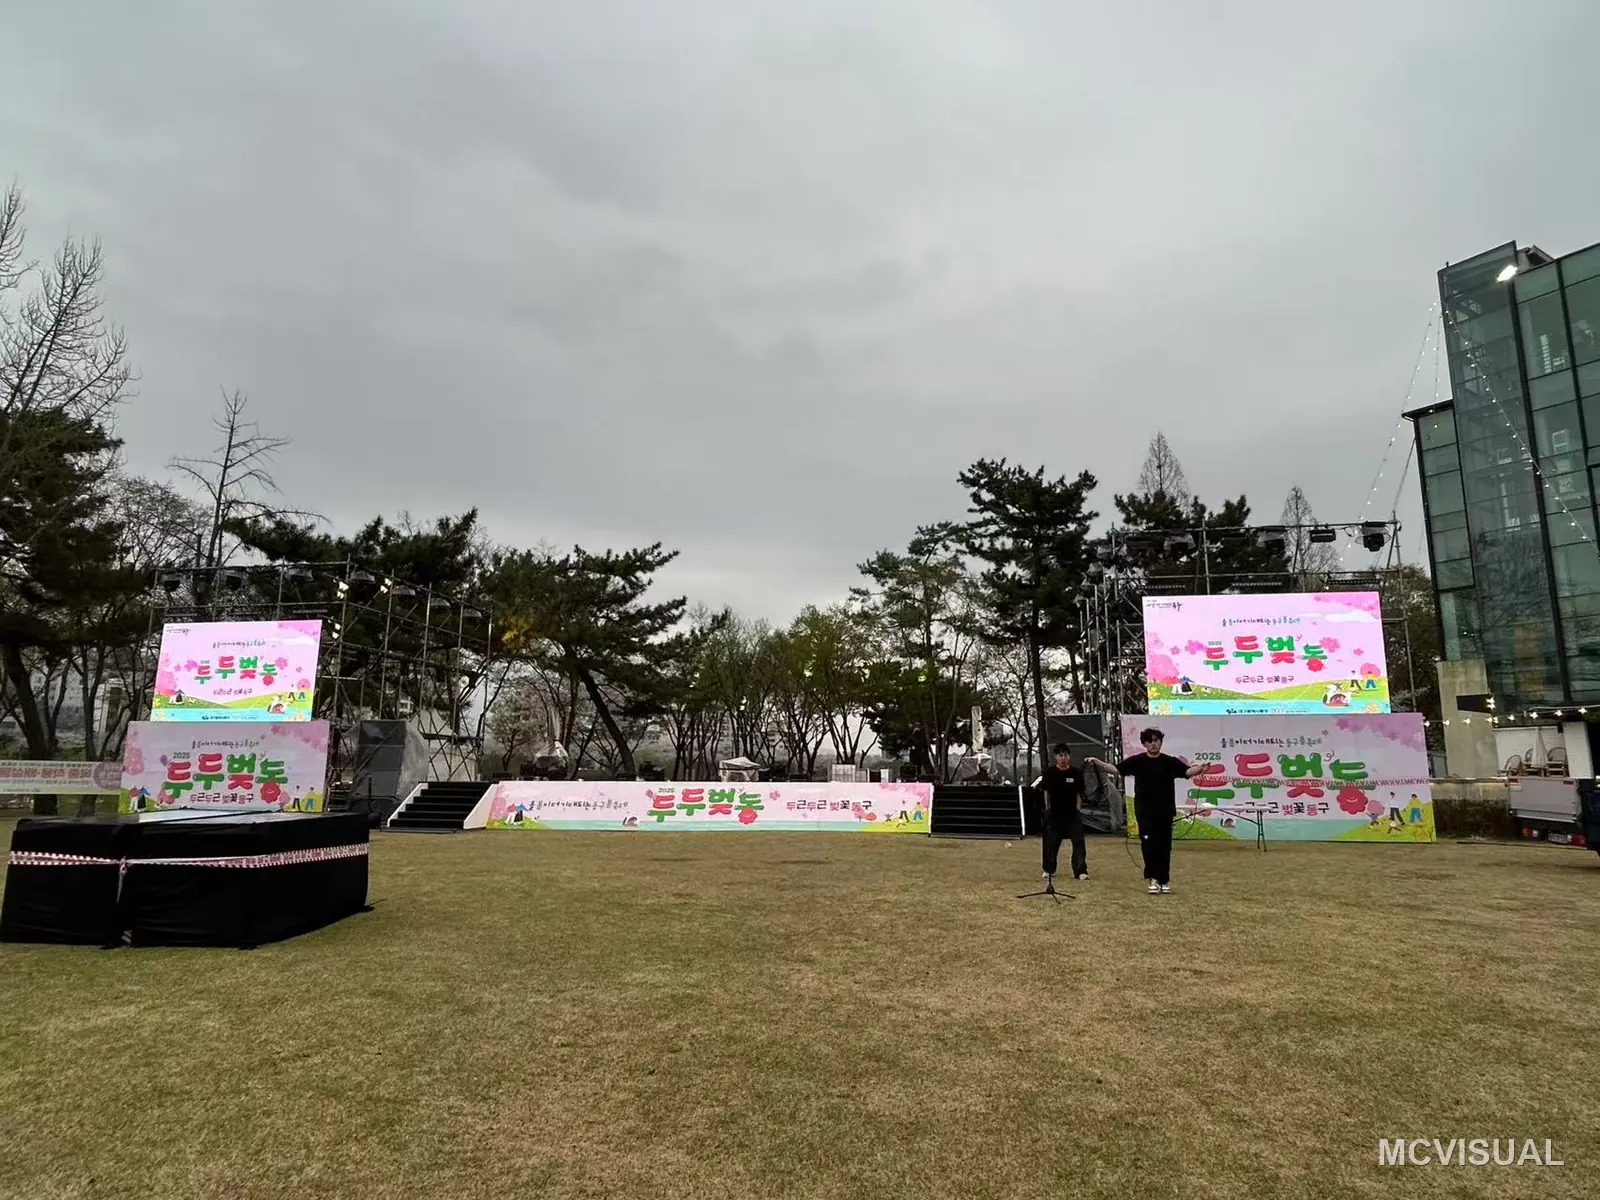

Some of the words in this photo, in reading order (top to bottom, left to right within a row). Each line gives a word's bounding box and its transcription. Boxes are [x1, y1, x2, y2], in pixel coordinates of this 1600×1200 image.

[1235, 675, 1264, 684] 두근두근
[172, 751, 190, 759] 2025
[1195, 752, 1221, 760] 2025
[190, 792, 221, 803] 두근두근
[786, 799, 827, 812] 두근두근
